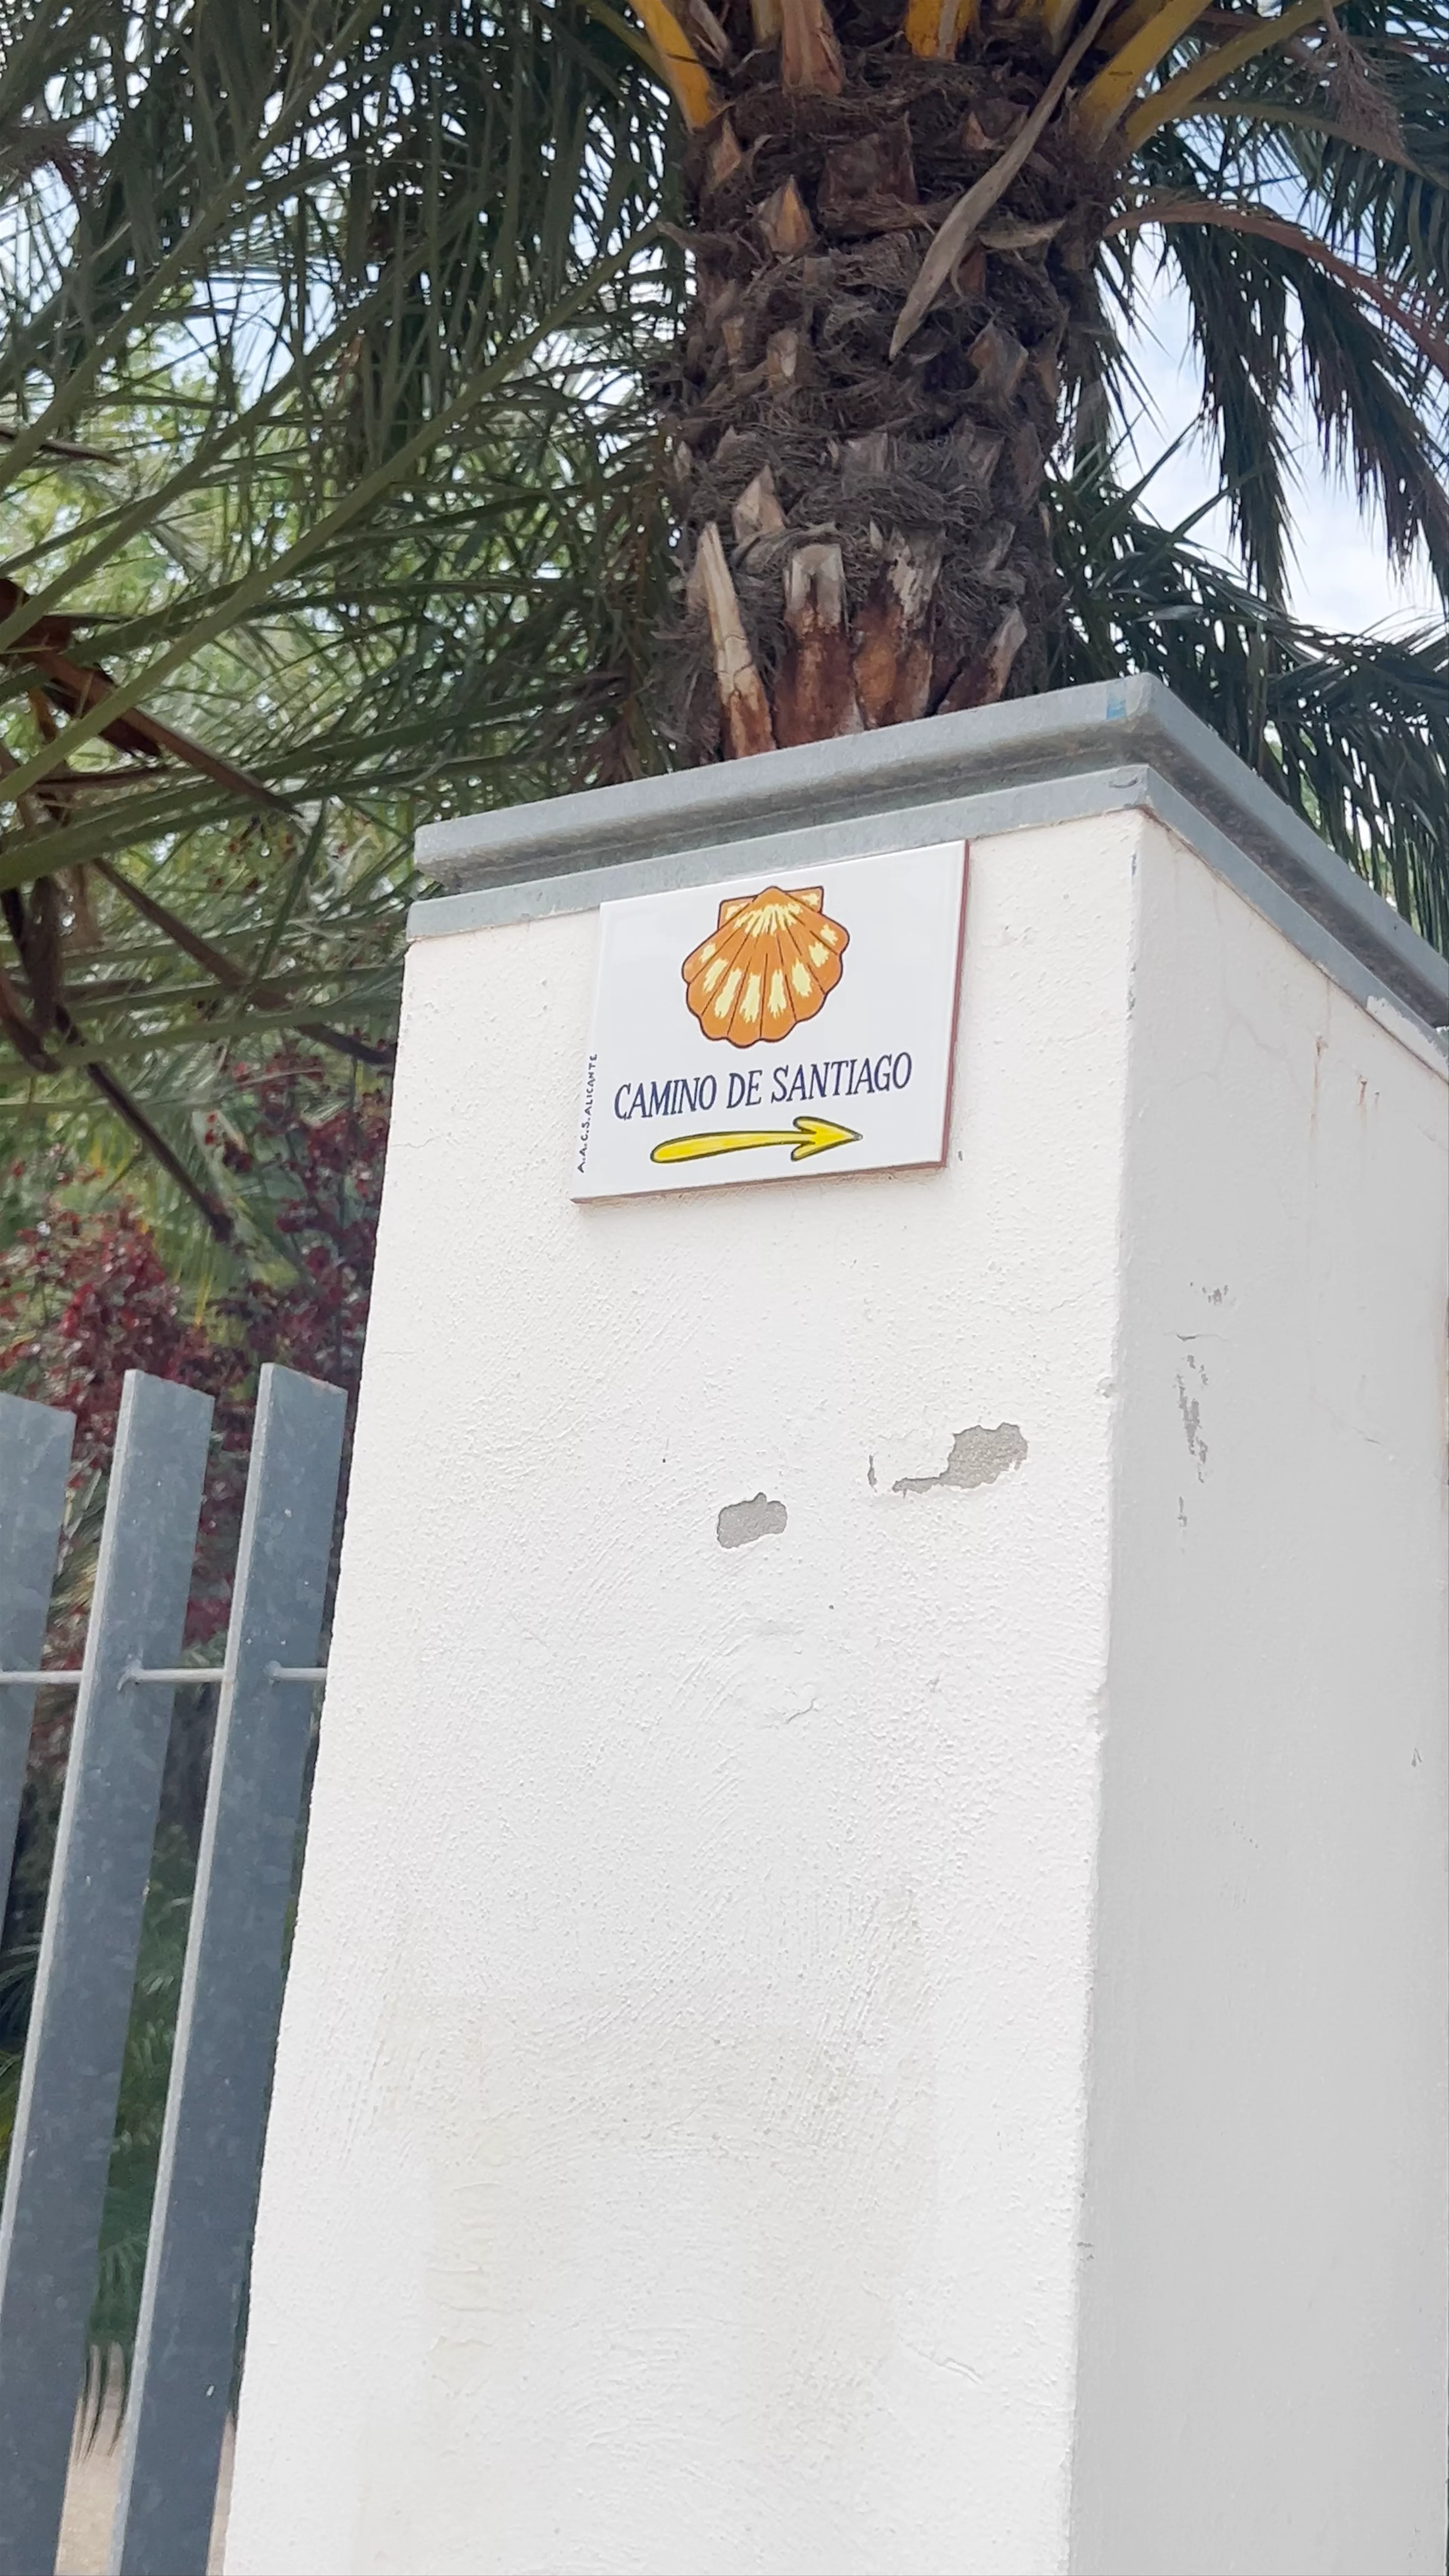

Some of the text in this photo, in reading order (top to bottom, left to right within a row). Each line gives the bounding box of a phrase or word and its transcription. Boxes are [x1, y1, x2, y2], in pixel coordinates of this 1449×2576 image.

[614, 1052, 912, 1121] CAMINO DE SANTIAGO
